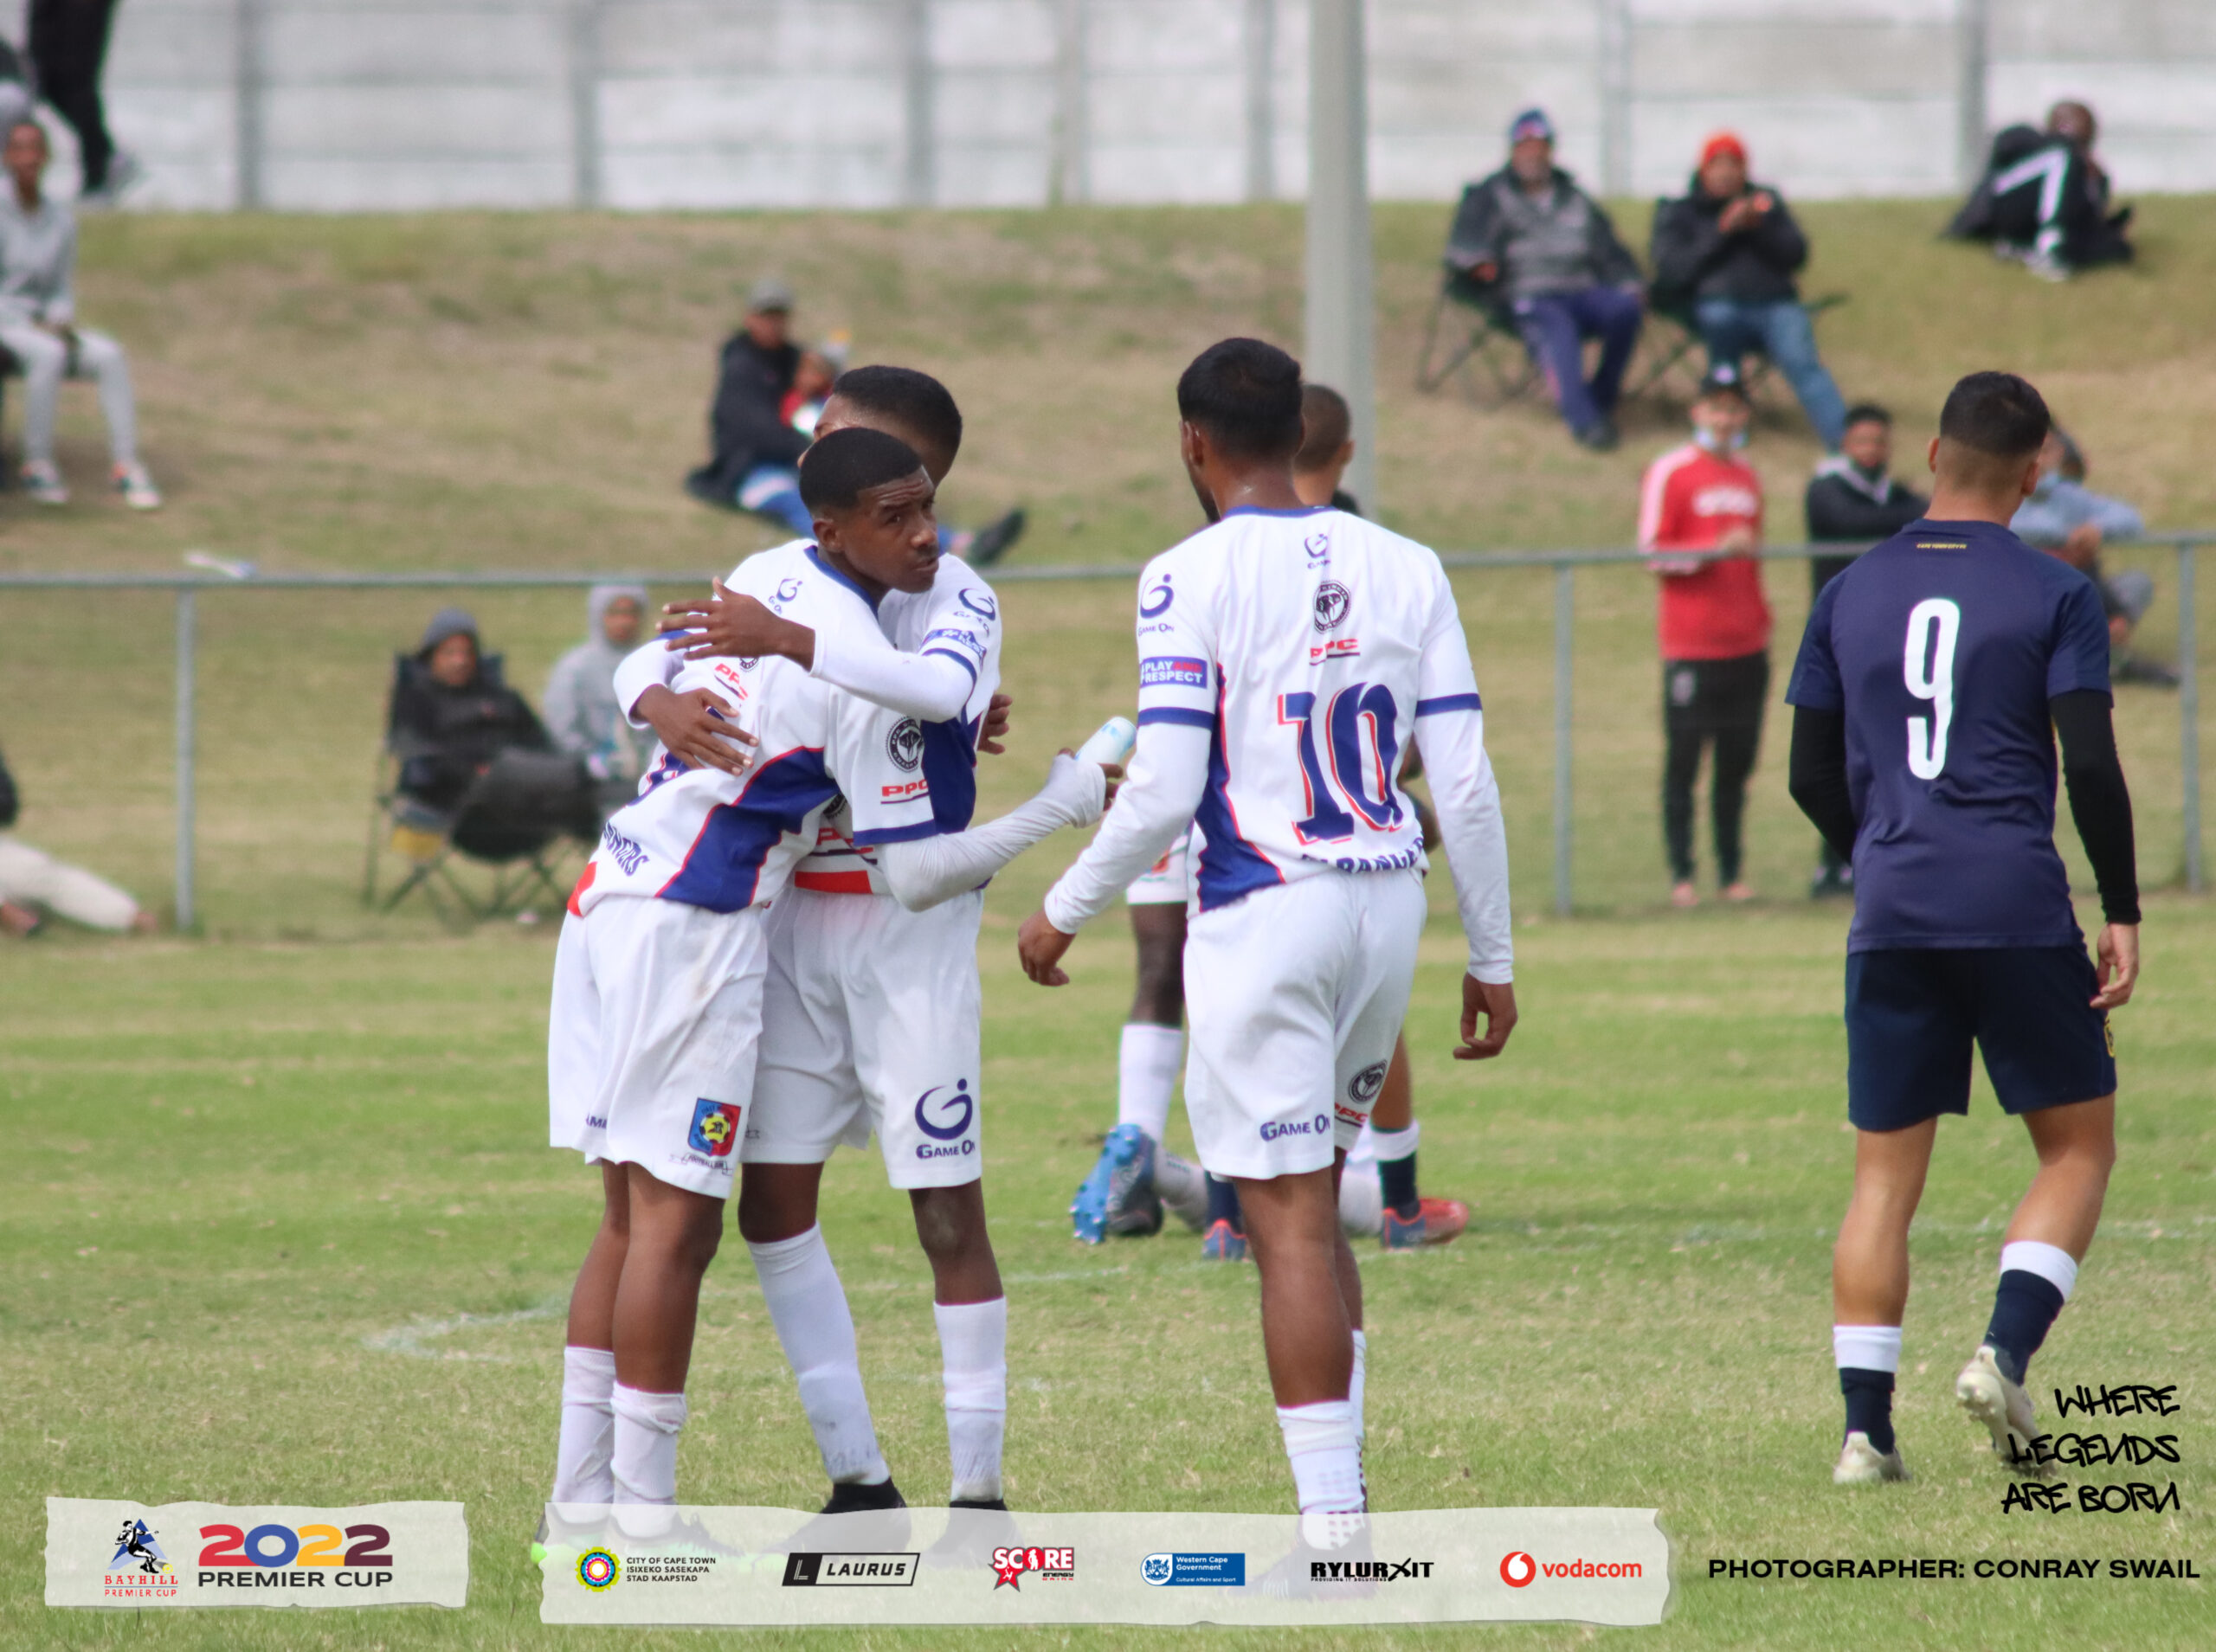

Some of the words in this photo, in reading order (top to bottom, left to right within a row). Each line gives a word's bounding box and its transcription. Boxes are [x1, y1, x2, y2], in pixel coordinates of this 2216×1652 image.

[1904, 598, 1960, 780] 9
[1278, 682, 1404, 845] 10
[916, 1144, 959, 1160] GAME
[1260, 1122, 1311, 1142] GAME
